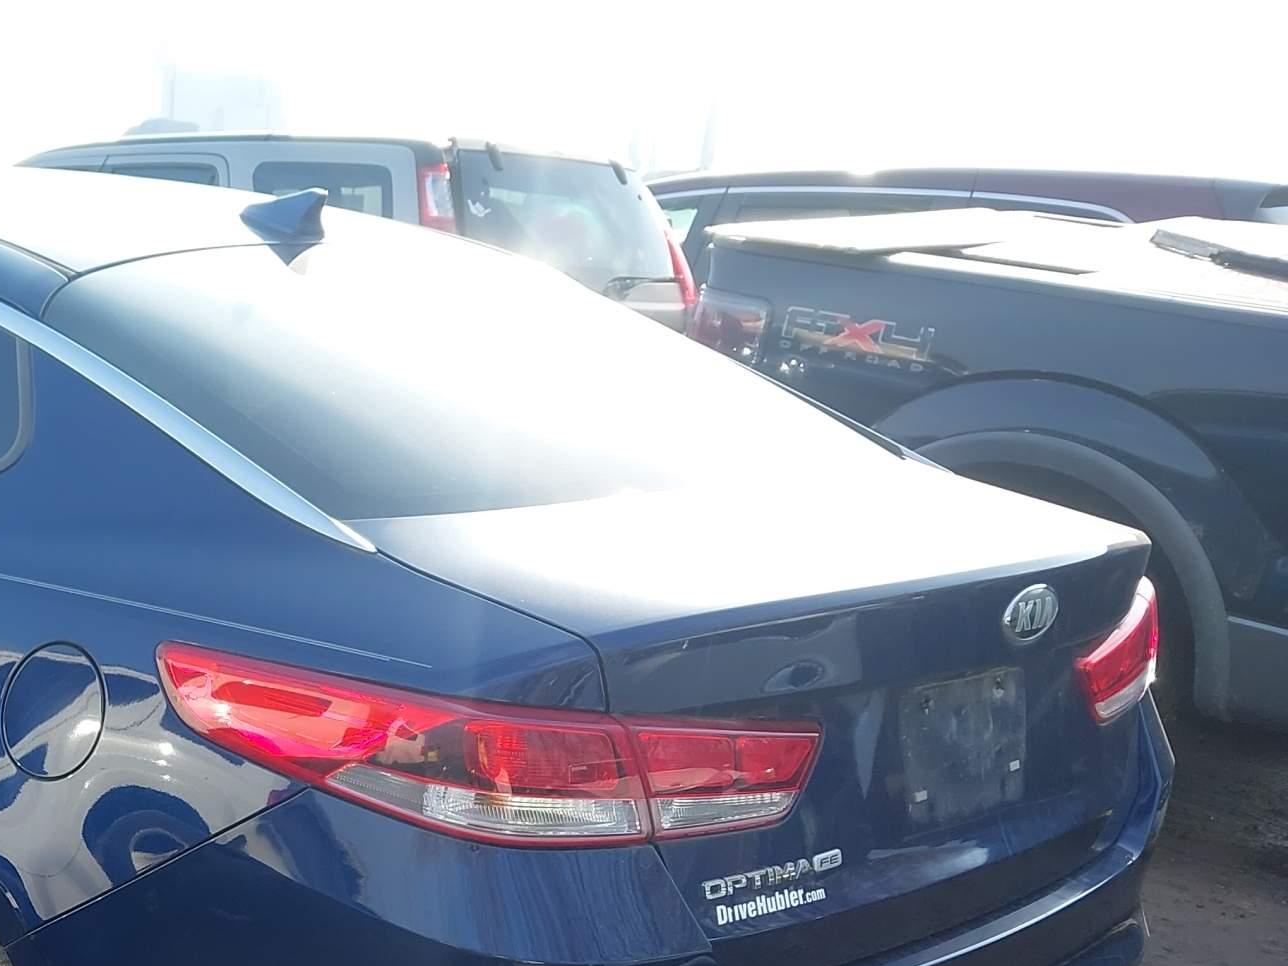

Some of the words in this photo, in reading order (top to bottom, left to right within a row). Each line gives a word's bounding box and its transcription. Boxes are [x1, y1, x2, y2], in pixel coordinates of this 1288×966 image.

[843, 350, 925, 373] ROAD
[1014, 596, 1053, 633] KIA
[701, 857, 812, 900] OPTIMA
[715, 887, 827, 926] DriveHubler.com
